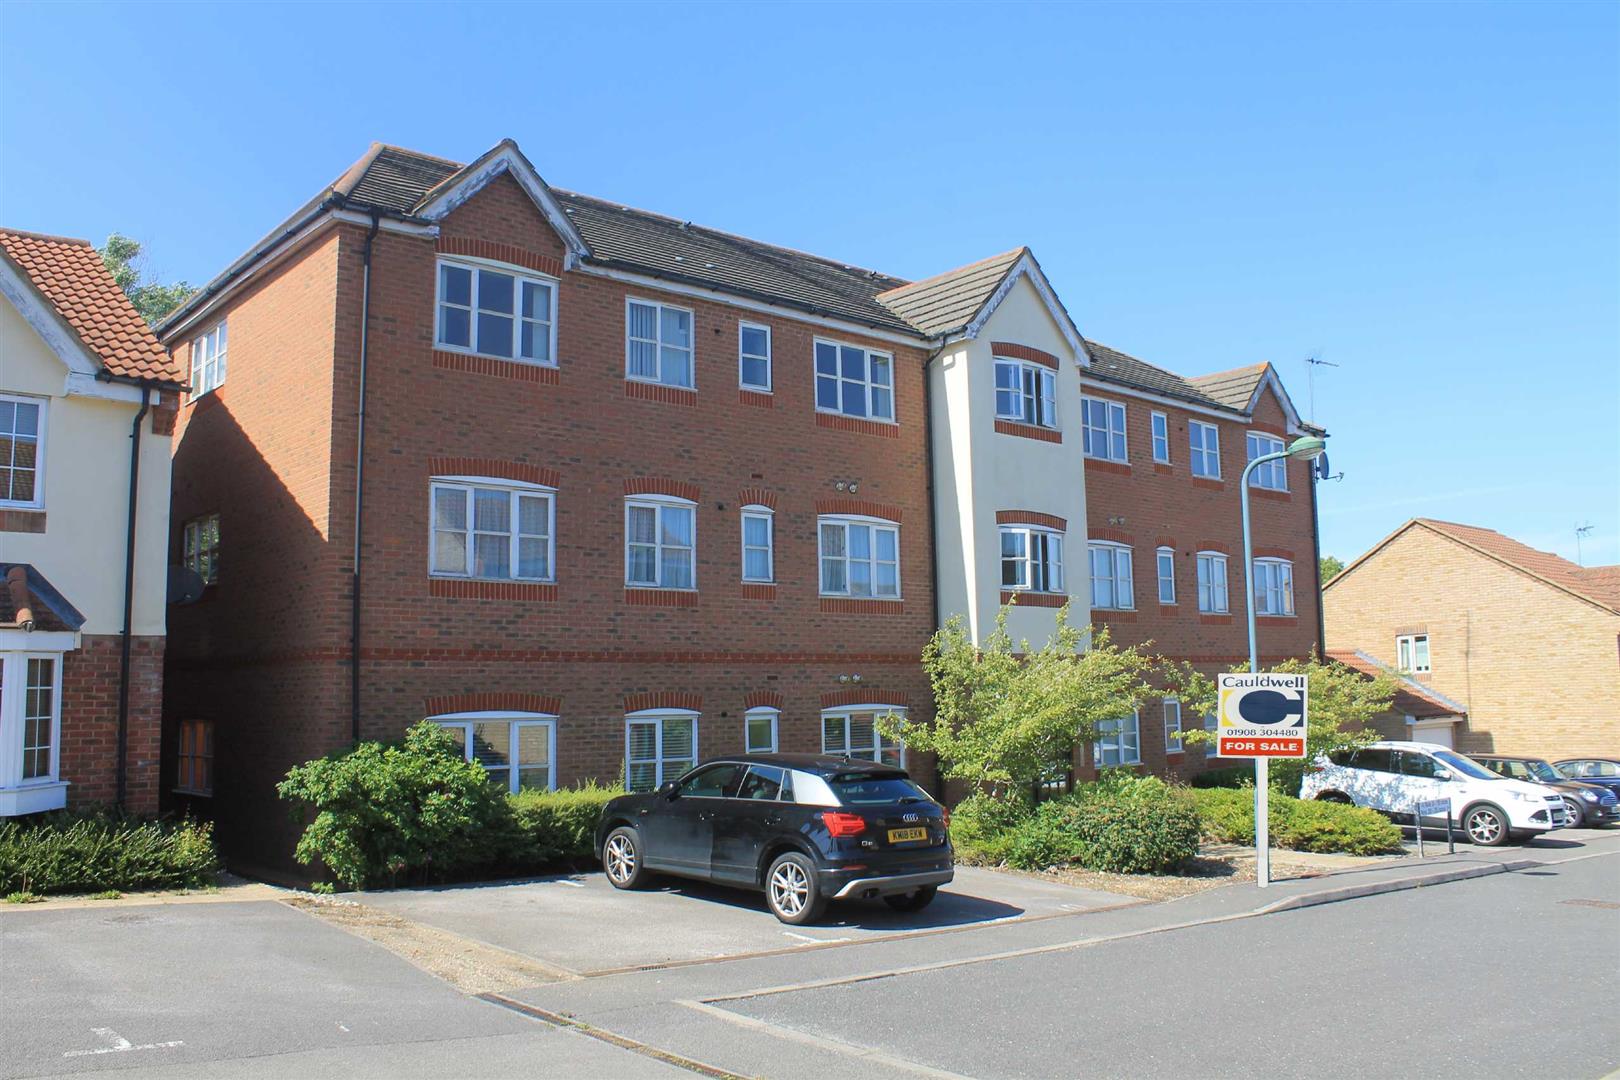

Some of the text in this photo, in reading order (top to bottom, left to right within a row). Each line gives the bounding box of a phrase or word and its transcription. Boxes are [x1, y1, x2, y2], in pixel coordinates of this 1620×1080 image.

[1223, 676, 1304, 687] Cauldwell
[1260, 729, 1298, 737] 304480
[1226, 742, 1298, 751] FOR SALE
